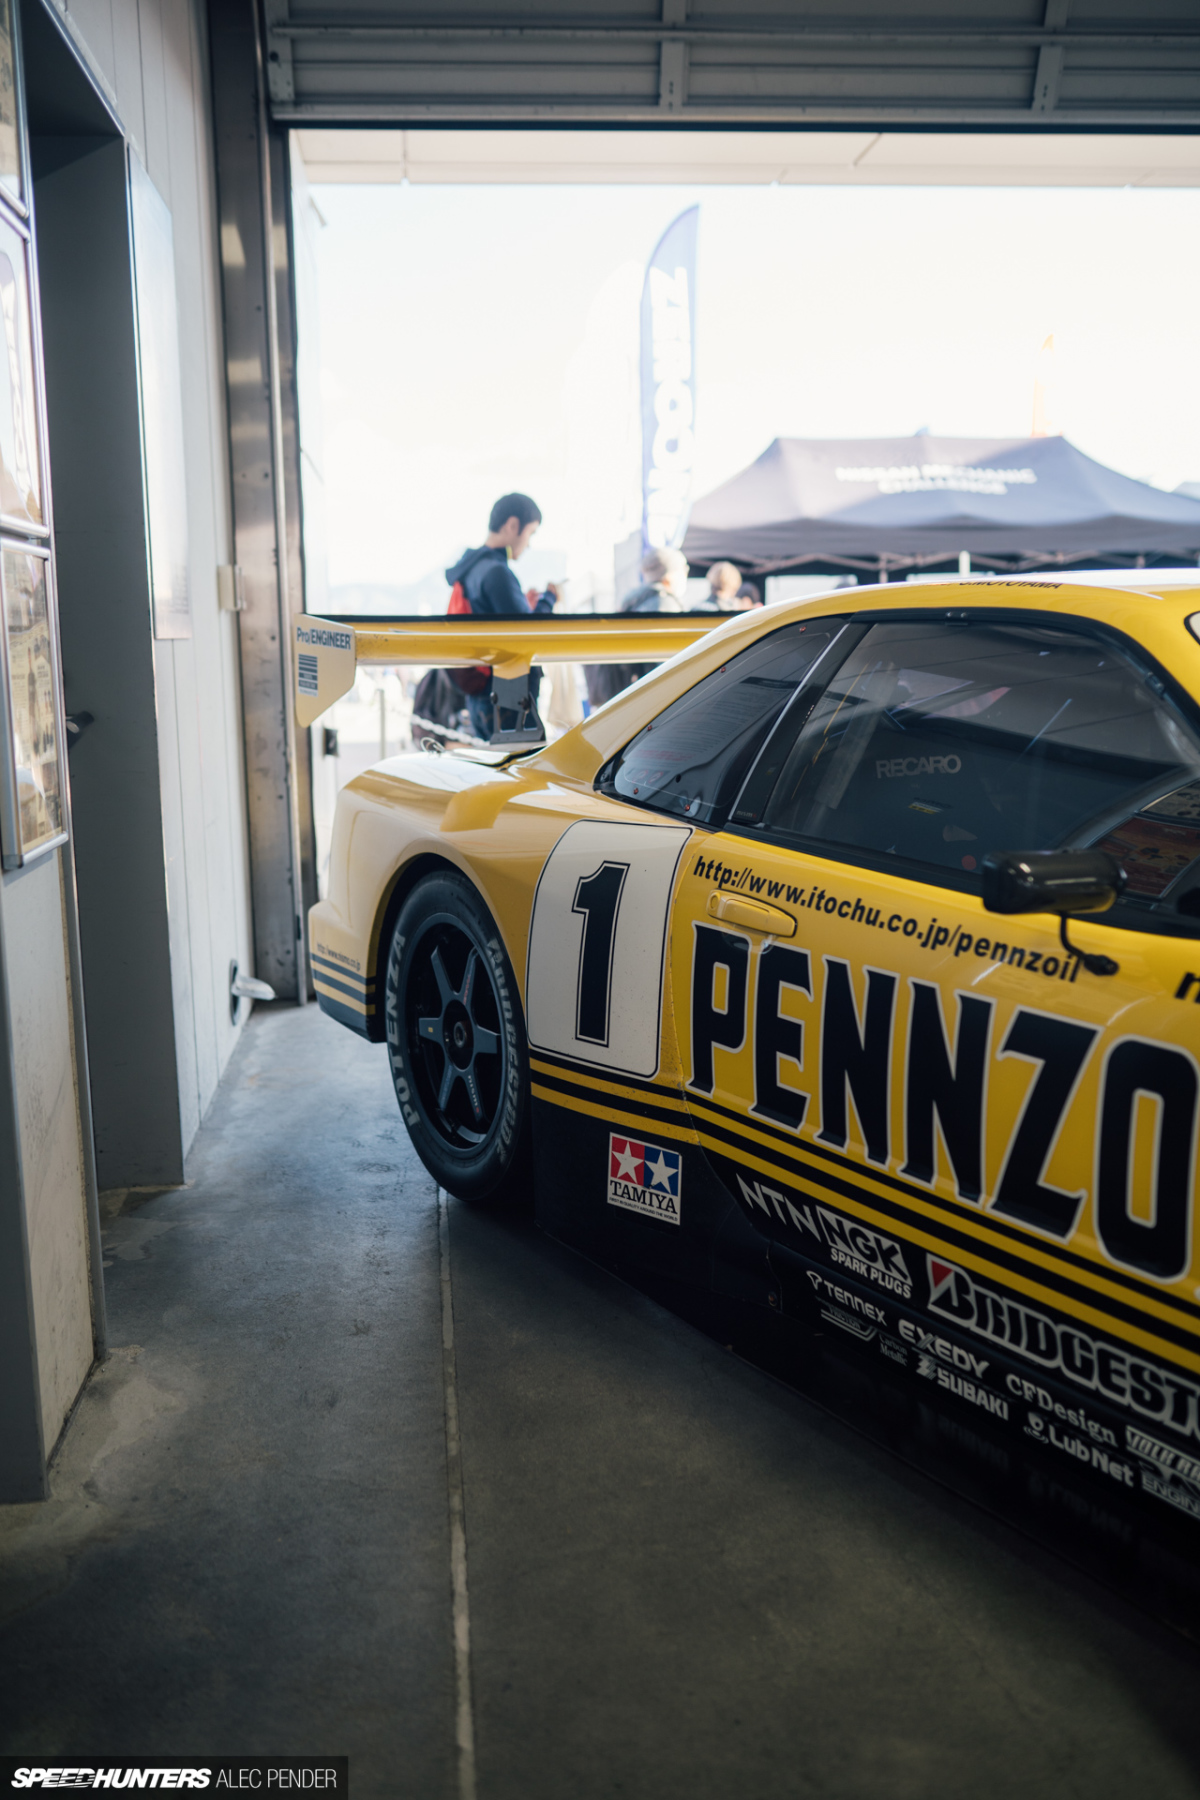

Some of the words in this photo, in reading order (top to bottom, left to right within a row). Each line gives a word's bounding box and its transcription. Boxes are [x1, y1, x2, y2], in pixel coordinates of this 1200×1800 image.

[876, 754, 962, 779] RECARO
[571, 860, 632, 1046] 1
[693, 855, 1082, 984] http://www.itochu.co.jp/pennzoil
[386, 931, 421, 1127] POTENZA
[609, 1180, 678, 1215] TAMIYA
[736, 1173, 821, 1243] NTN
[816, 1206, 912, 1287] NGK
[831, 1248, 869, 1278] SPARK
[870, 1268, 912, 1299] PLUGS
[898, 1318, 989, 1380] EXEDY
[926, 1253, 1200, 1438] BRIDGEST
[1005, 1373, 1119, 1448] CFDesign
